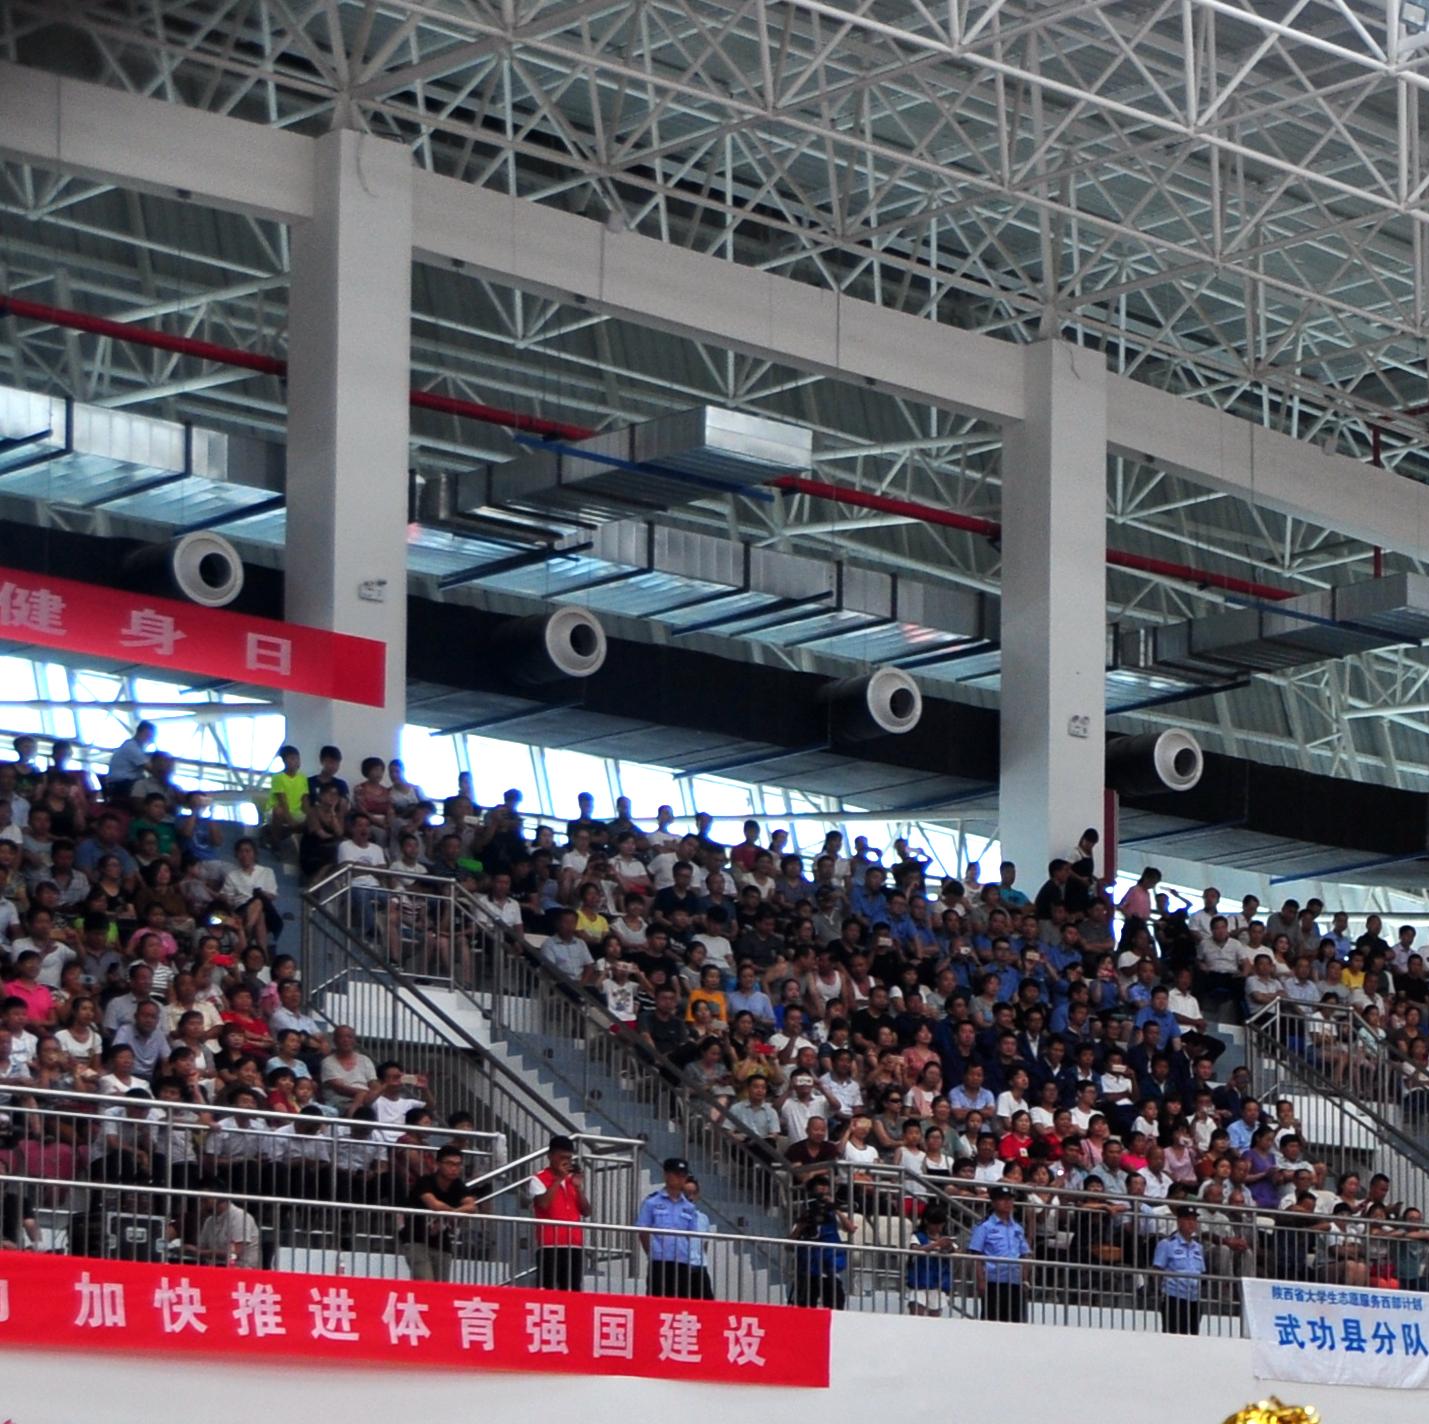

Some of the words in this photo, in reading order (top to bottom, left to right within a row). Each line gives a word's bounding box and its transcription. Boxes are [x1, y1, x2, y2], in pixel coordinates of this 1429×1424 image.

[74, 1271, 767, 1367] 加快推进体育强国建设
[1274, 1314, 1429, 1357] 武功县分队
